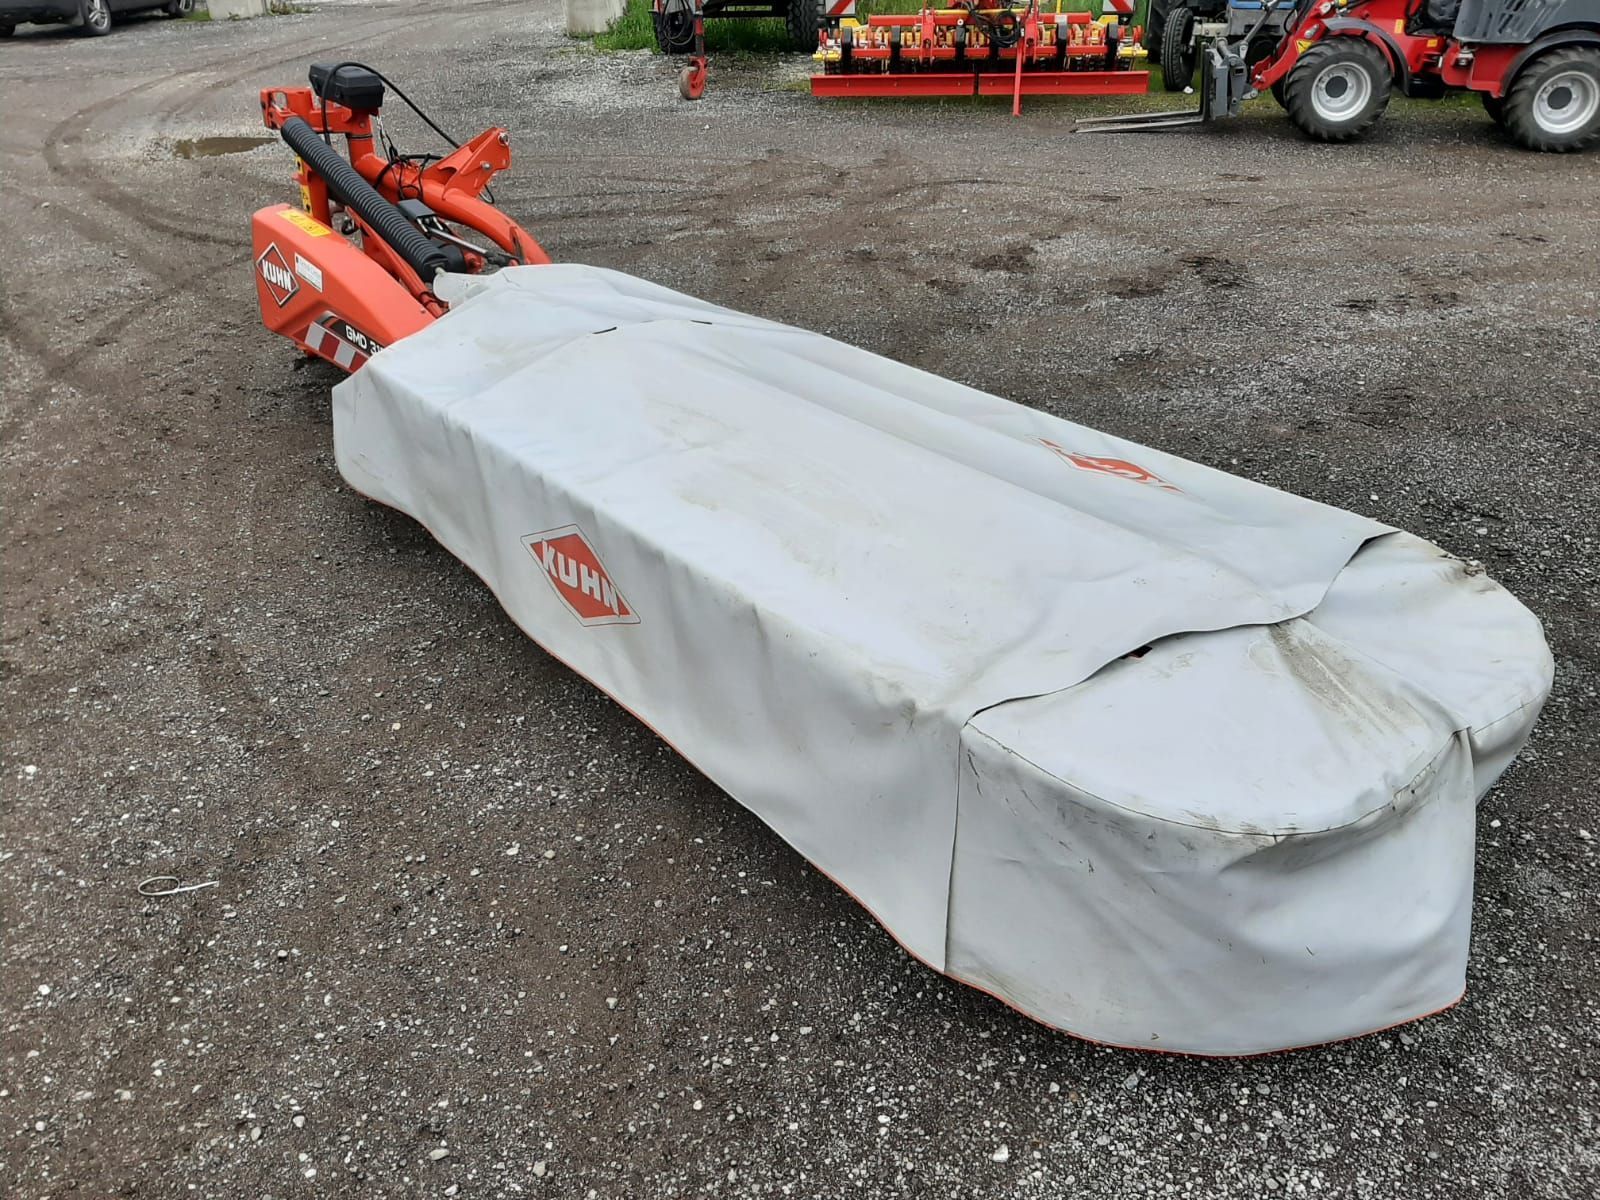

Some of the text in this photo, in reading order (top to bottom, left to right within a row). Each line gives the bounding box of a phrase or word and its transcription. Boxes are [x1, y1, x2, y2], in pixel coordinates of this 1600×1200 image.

[262, 259, 292, 292] KUHN
[345, 324, 367, 350] GMD
[541, 539, 620, 616] KUHN
